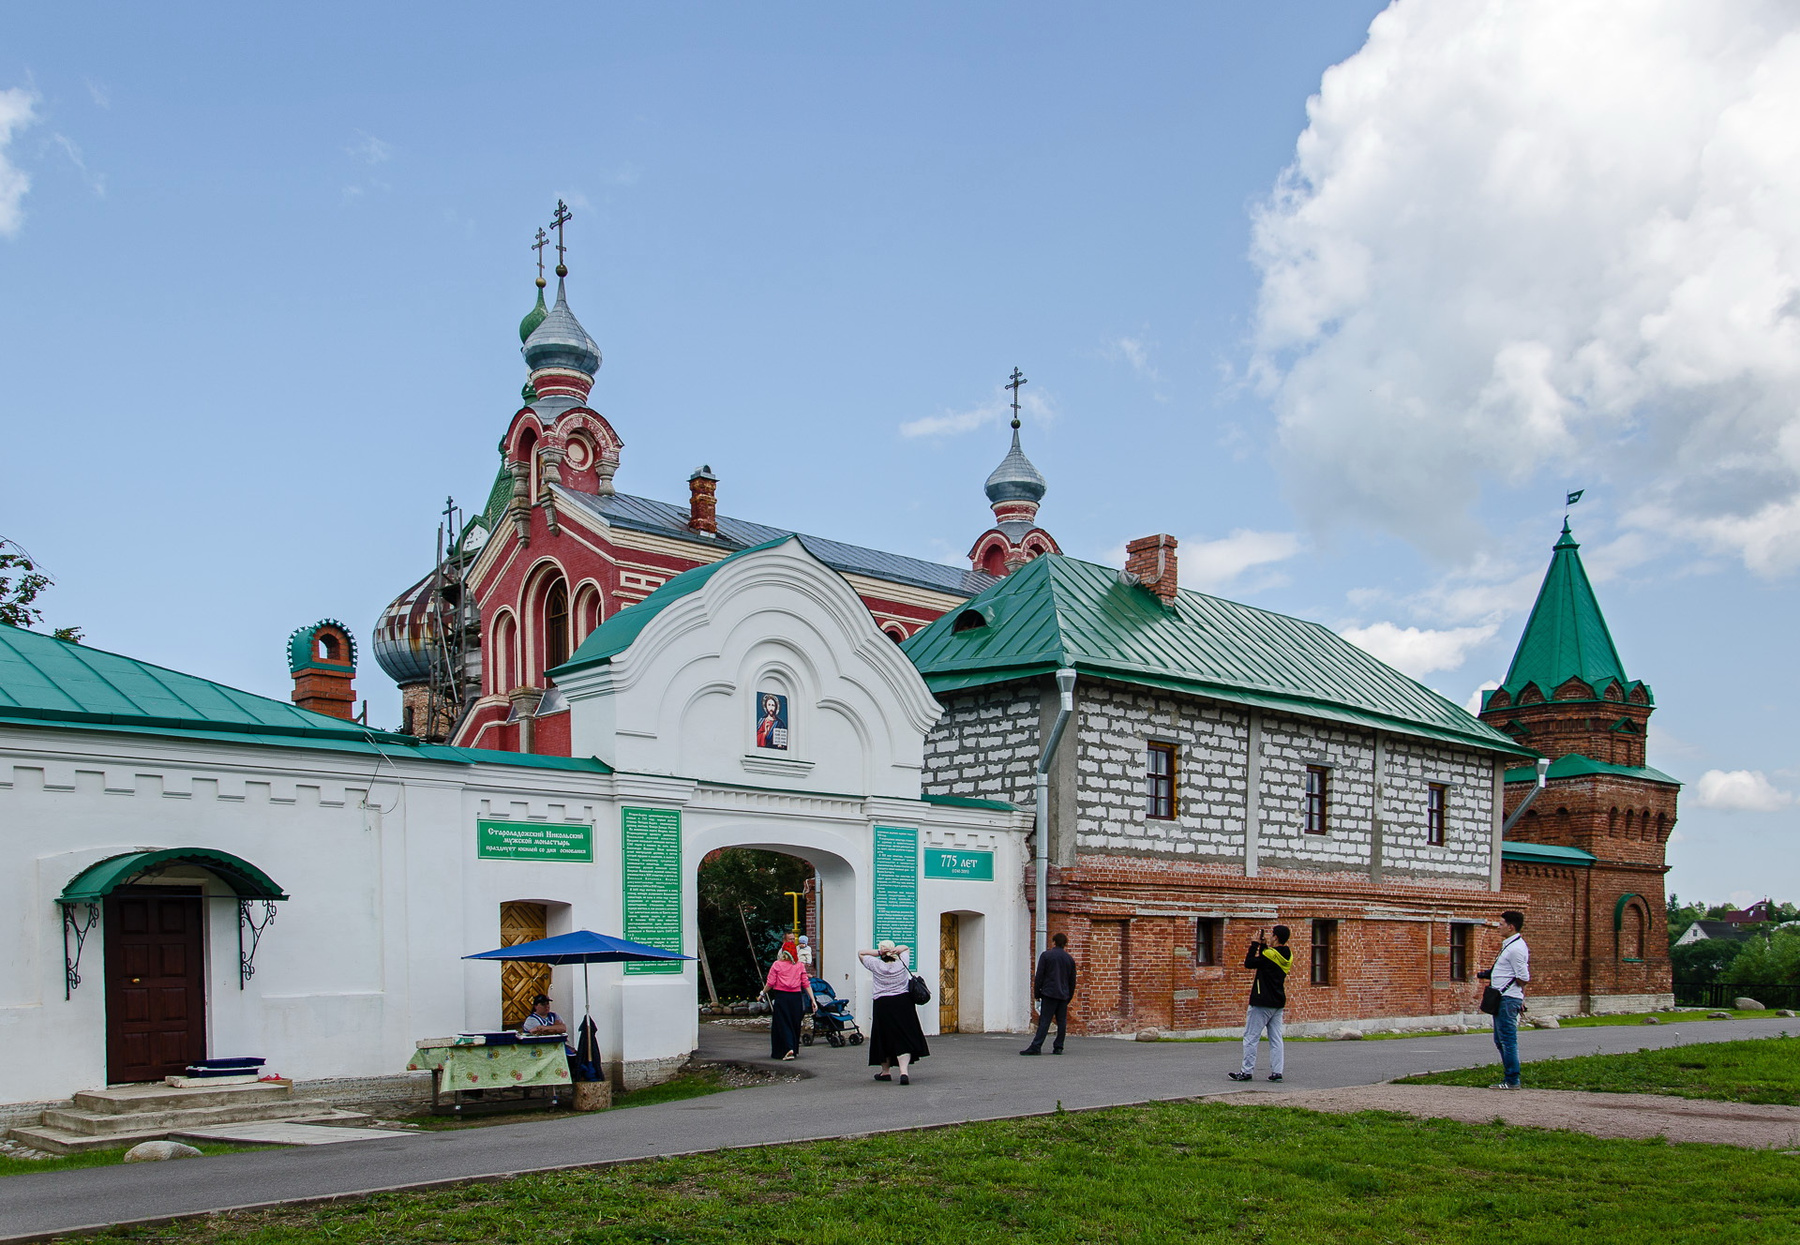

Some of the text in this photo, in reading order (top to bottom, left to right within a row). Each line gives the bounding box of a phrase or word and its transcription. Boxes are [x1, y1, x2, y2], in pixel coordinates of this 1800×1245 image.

[546, 831, 583, 839] Никольский
[534, 839, 570, 847] монастырь
[941, 854, 957, 867] 775
